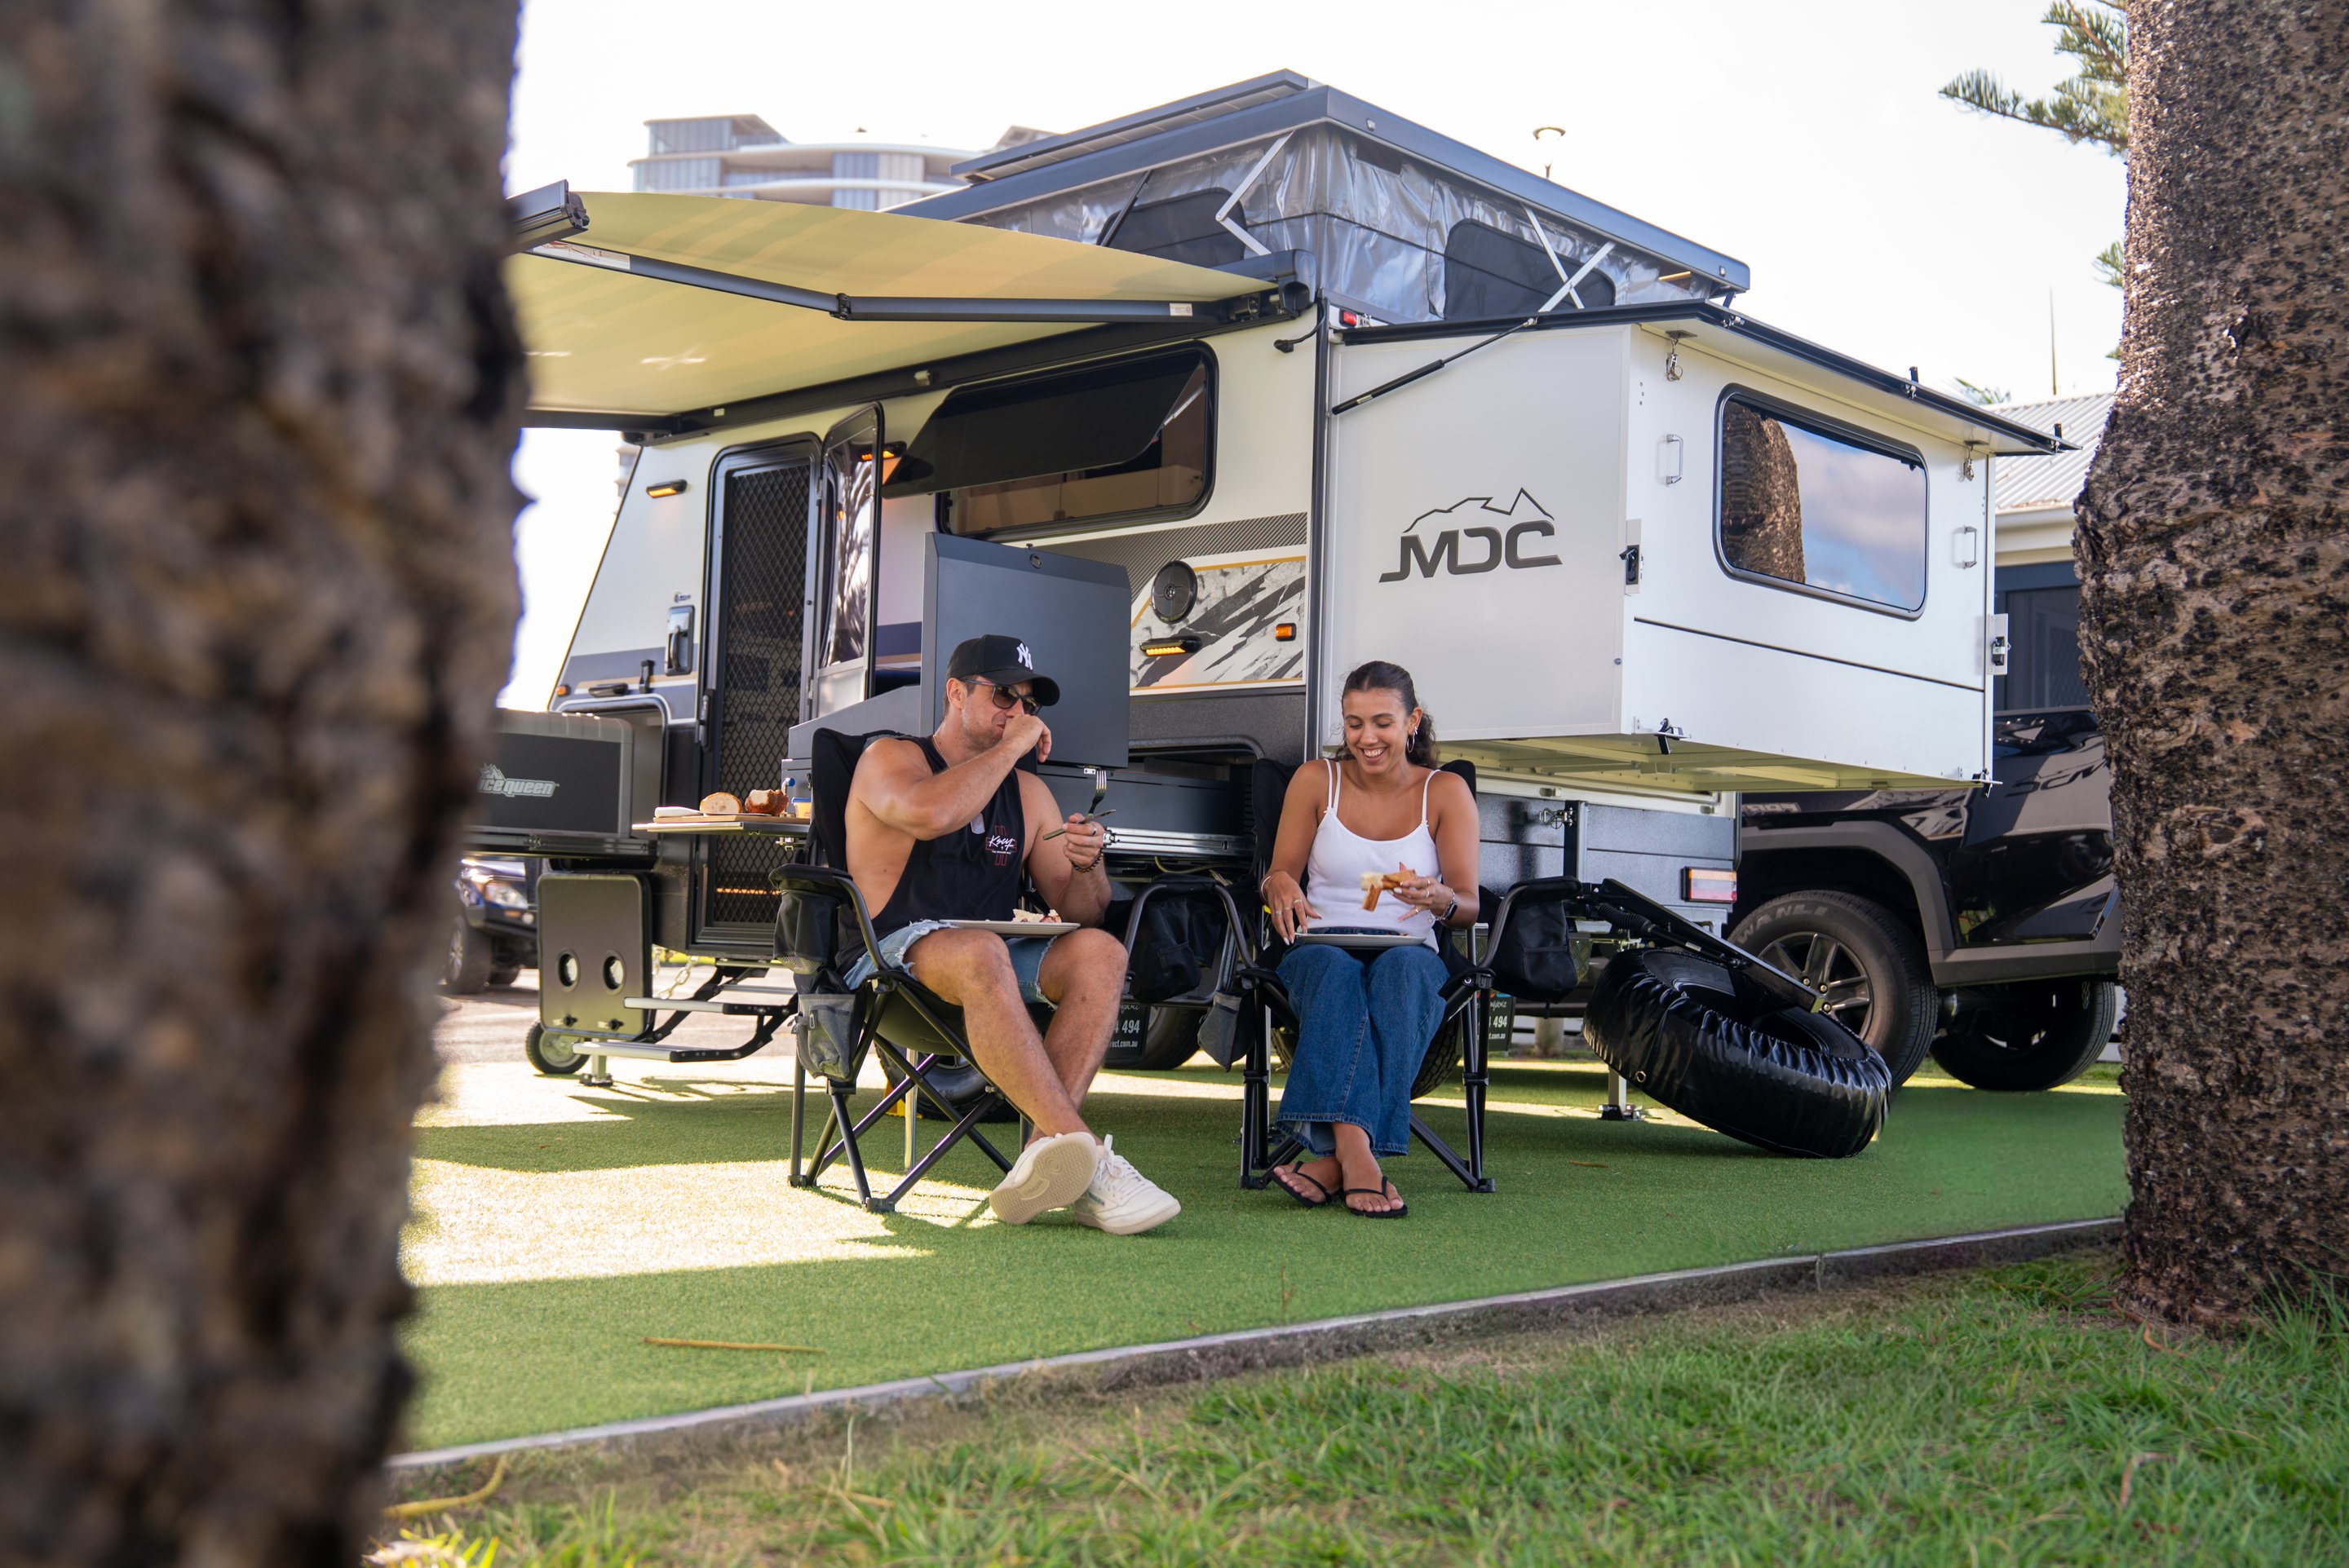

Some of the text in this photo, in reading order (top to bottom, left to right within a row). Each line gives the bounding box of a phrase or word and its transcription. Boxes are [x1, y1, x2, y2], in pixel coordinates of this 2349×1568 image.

[1378, 519, 1563, 583] MDC
[1016, 643, 1033, 670] NY
[1736, 903, 1829, 944] WANLI
[1121, 1019, 1140, 1034] 494
[1493, 1015, 1507, 1027] 494
